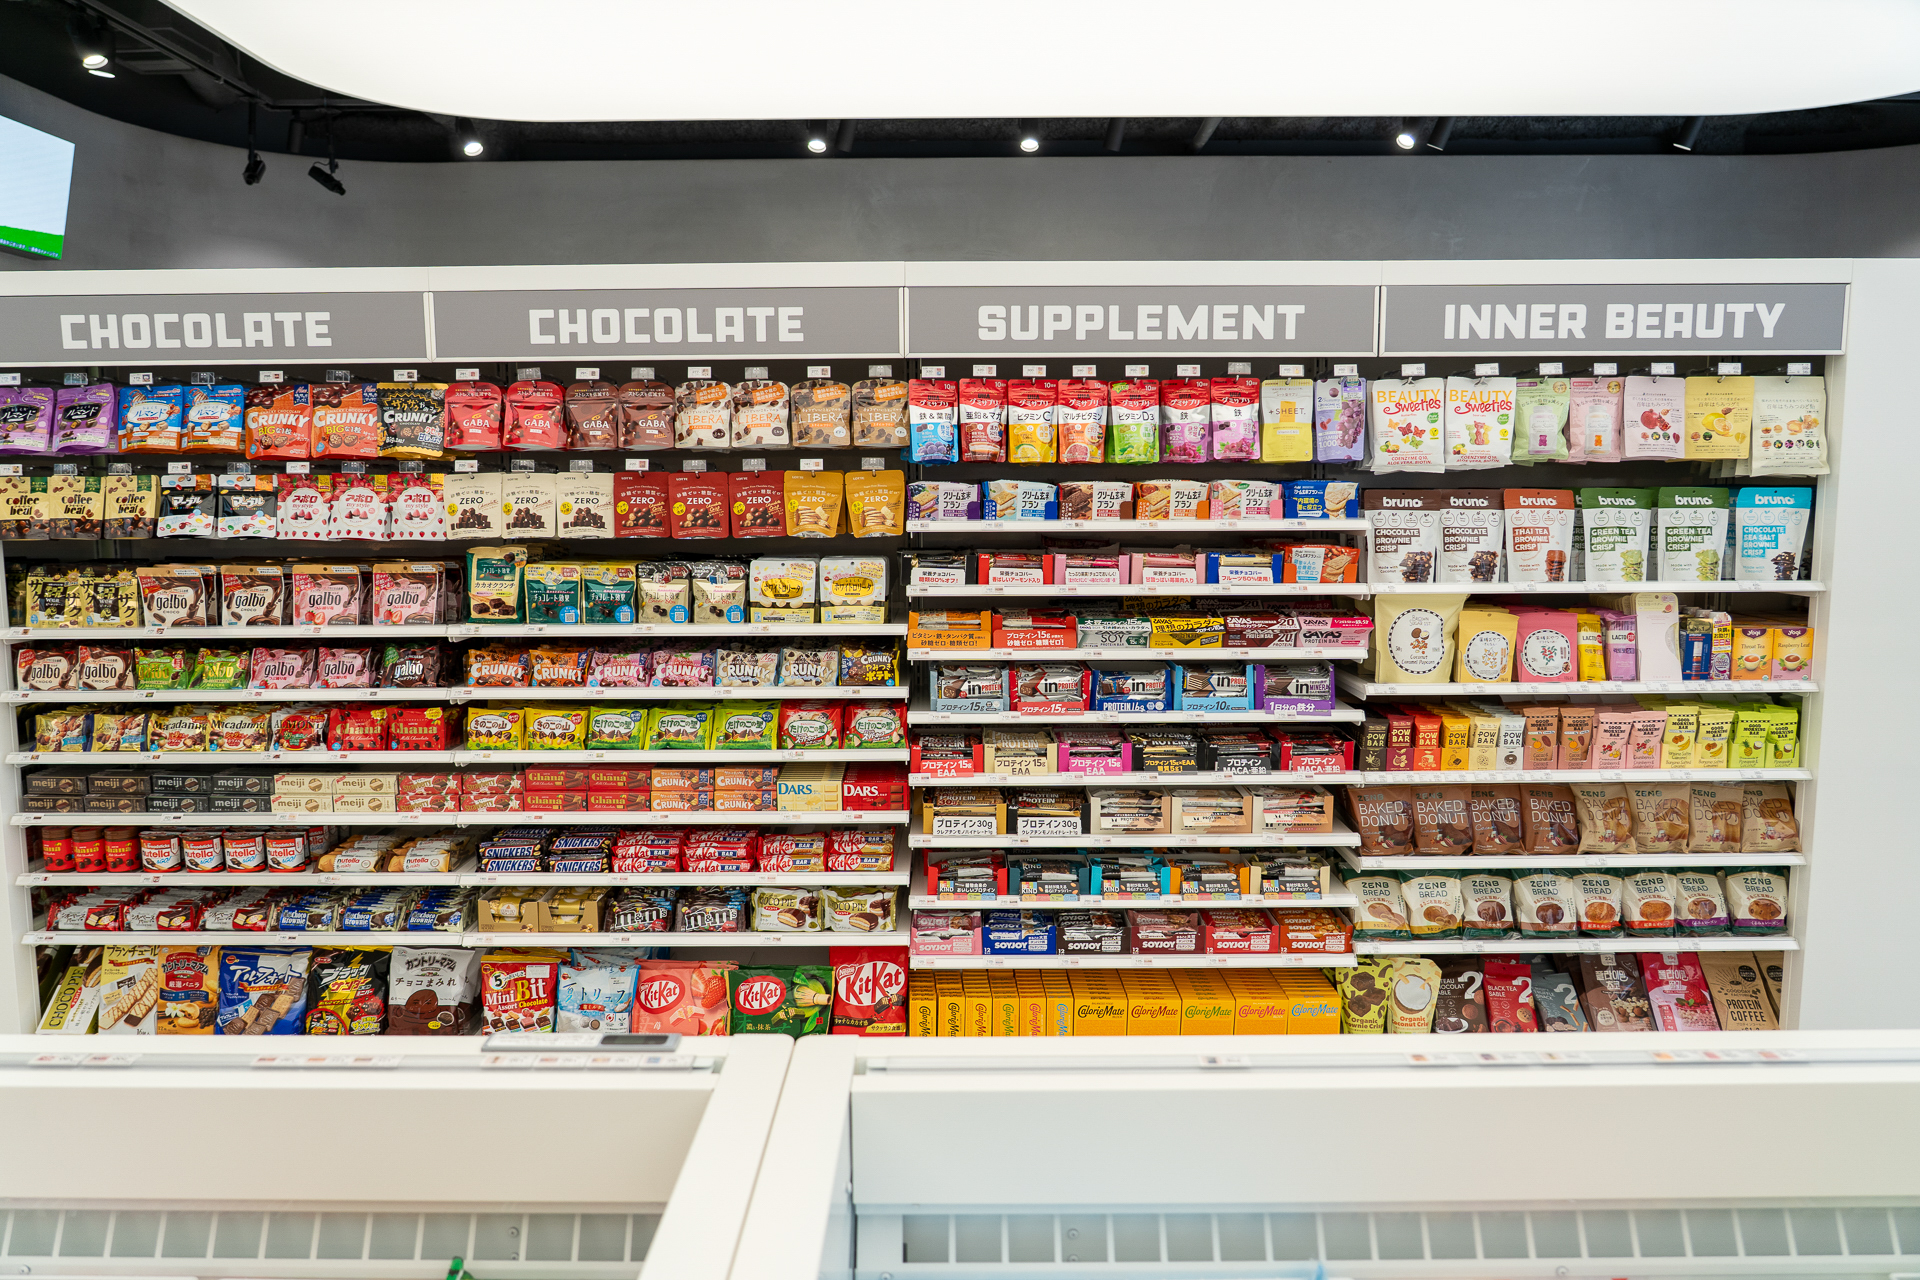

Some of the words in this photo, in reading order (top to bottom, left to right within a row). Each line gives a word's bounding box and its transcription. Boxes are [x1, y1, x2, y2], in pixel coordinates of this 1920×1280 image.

[529, 306, 804, 344] CHOCOLATE
[977, 304, 1306, 340] SUPPLEMENT
[1443, 303, 1587, 338] INNER
[1605, 302, 1786, 340] BEAUTY
[60, 311, 332, 349] CHOCOLATE
[1377, 389, 1441, 402] BEAUTY
[1449, 389, 1513, 402] BEAUTY
[1383, 399, 1443, 414] Sweeties
[1454, 400, 1514, 414] Sweeties
[383, 410, 438, 424] CRUNKY
[799, 412, 844, 423] LIBERA
[1018, 411, 1051, 422] ビタミンC
[1063, 412, 1102, 421] マルチビタミン
[1181, 412, 1188, 420] 鉄
[1234, 409, 1242, 417] 鉄
[248, 412, 310, 429] CRUNKY
[313, 411, 377, 428] CRUNKY
[463, 419, 490, 428] GABA
[524, 418, 551, 428] GABA
[681, 413, 724, 425] LIBERA
[6, 495, 39, 506] coffee
[61, 495, 92, 506] coffee
[460, 497, 483, 505] ZERO
[574, 497, 599, 505] ZERO
[630, 496, 655, 505] ZERO
[1382, 496, 1422, 507] bruno
[1450, 496, 1489, 507] bruno
[1519, 496, 1556, 506] bruno
[1597, 495, 1635, 505] bruno
[10, 505, 33, 515] beat
[64, 505, 85, 516] beat
[1591, 528, 1616, 536] GREEN
[1620, 528, 1635, 536] TEA
[1376, 544, 1397, 552] CRISP
[156, 594, 187, 610] galbo
[387, 593, 419, 607] galbo
[1101, 634, 1124, 643] SOY
[861, 655, 892, 664] CRUNKY
[264, 663, 295, 678] galbo
[471, 663, 523, 678] CRUNKY
[657, 663, 708, 678] CRUNKY
[1045, 678, 1057, 693] in
[1296, 681, 1308, 695] in
[1104, 702, 1129, 711] PROTEIN
[335, 723, 382, 734] Ghana
[1011, 767, 1030, 776] EAA
[158, 778, 182, 787] meiji
[281, 778, 305, 787] meiji
[528, 773, 563, 782] Ghana
[33, 779, 56, 788] meiji
[778, 783, 812, 795] DARS
[844, 784, 878, 797] DARS
[1692, 788, 1716, 797] ZENB
[1359, 801, 1403, 814] BAKED
[1693, 799, 1734, 810] BAKED
[1361, 814, 1407, 826] DONUT
[1694, 810, 1739, 821] DONUT
[555, 838, 602, 849] SNICKERS
[406, 857, 429, 865] nutella
[488, 859, 535, 871] SNICKERS
[829, 857, 860, 870] KitKat
[1363, 888, 1390, 896] BREAD
[1638, 886, 1666, 894] BREAD
[494, 974, 503, 986] 5
[846, 964, 904, 1005] KitKat
[1464, 972, 1483, 999] 2
[48, 989, 75, 1027] CHOCO
[73, 968, 85, 988] PIE
[486, 991, 515, 1005] Mini
[516, 979, 546, 1005] Bit
[639, 981, 679, 1007] KitKat
[742, 982, 781, 1008] KitKat
[519, 998, 548, 1008] Chocolate
[1726, 999, 1761, 1010] PROTEIN
[1078, 1005, 1124, 1019] CalorieMate
[1131, 1005, 1178, 1019] CalorieMate
[1730, 1011, 1765, 1022] COFFEE
